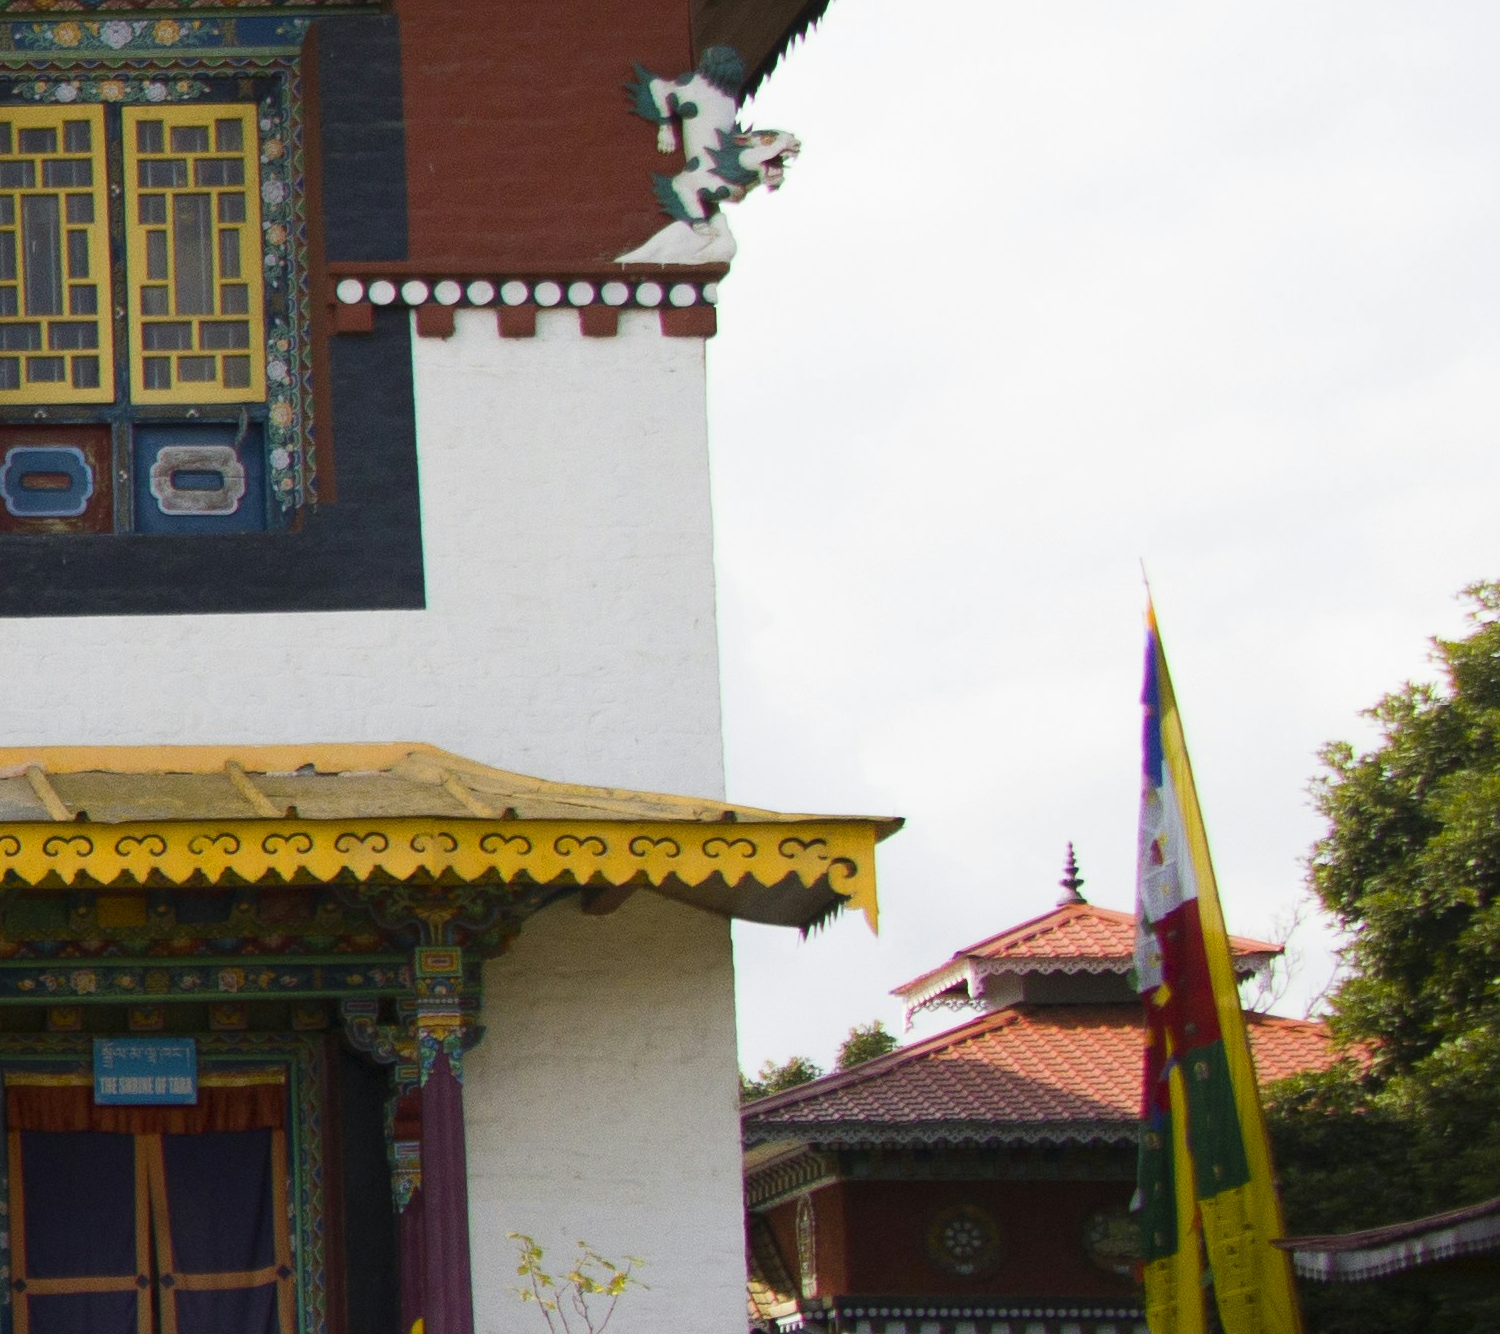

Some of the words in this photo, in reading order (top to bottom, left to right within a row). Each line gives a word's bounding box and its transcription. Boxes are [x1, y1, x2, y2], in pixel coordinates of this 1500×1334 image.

[100, 1077, 117, 1094] THE
[118, 1077, 154, 1094] SHRINE
[155, 1077, 166, 1094] OF
[168, 1077, 193, 1094] TARA
